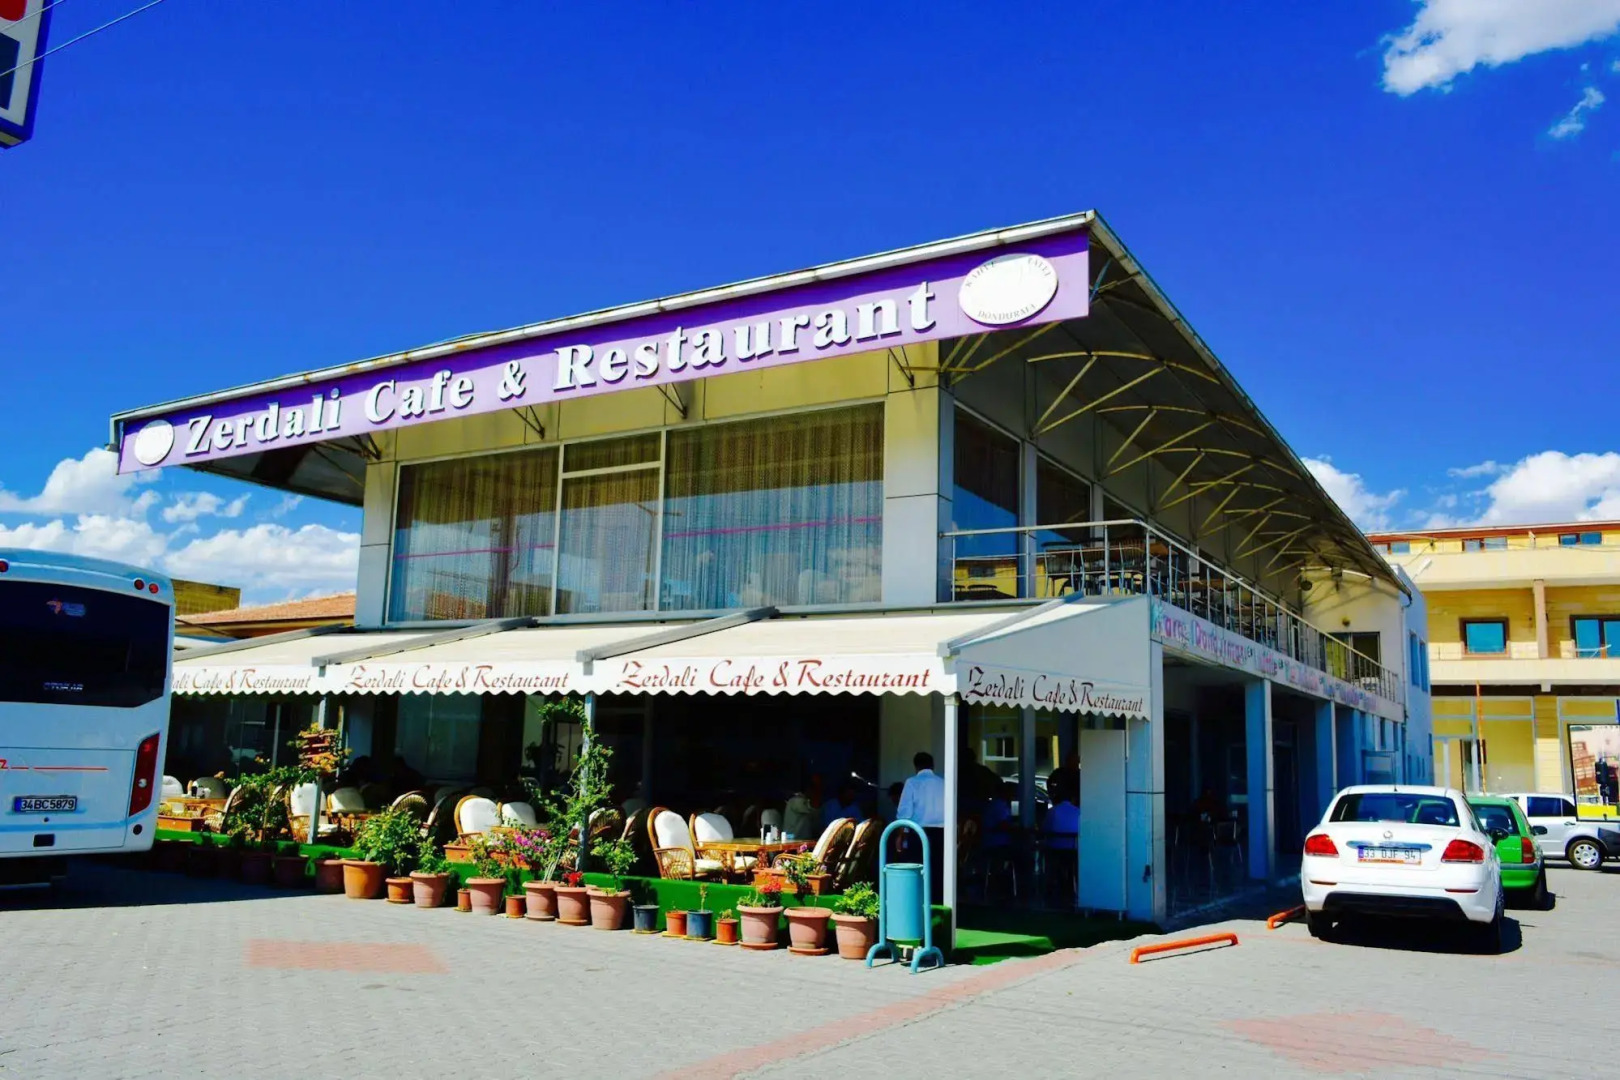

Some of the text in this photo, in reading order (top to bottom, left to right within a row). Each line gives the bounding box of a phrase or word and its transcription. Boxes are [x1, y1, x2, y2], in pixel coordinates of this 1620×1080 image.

[184, 281, 937, 457] Zerdali Cafe & Restaurant
[192, 669, 221, 691] Cafe
[225, 670, 237, 689] &
[239, 669, 312, 689] Restaurant
[345, 664, 569, 693] Zerdali Cafe & Restaurant
[616, 659, 930, 694] Zerdali Cafe & Restaurant
[965, 666, 1143, 712] Zerdali Cafe & Restaurant
